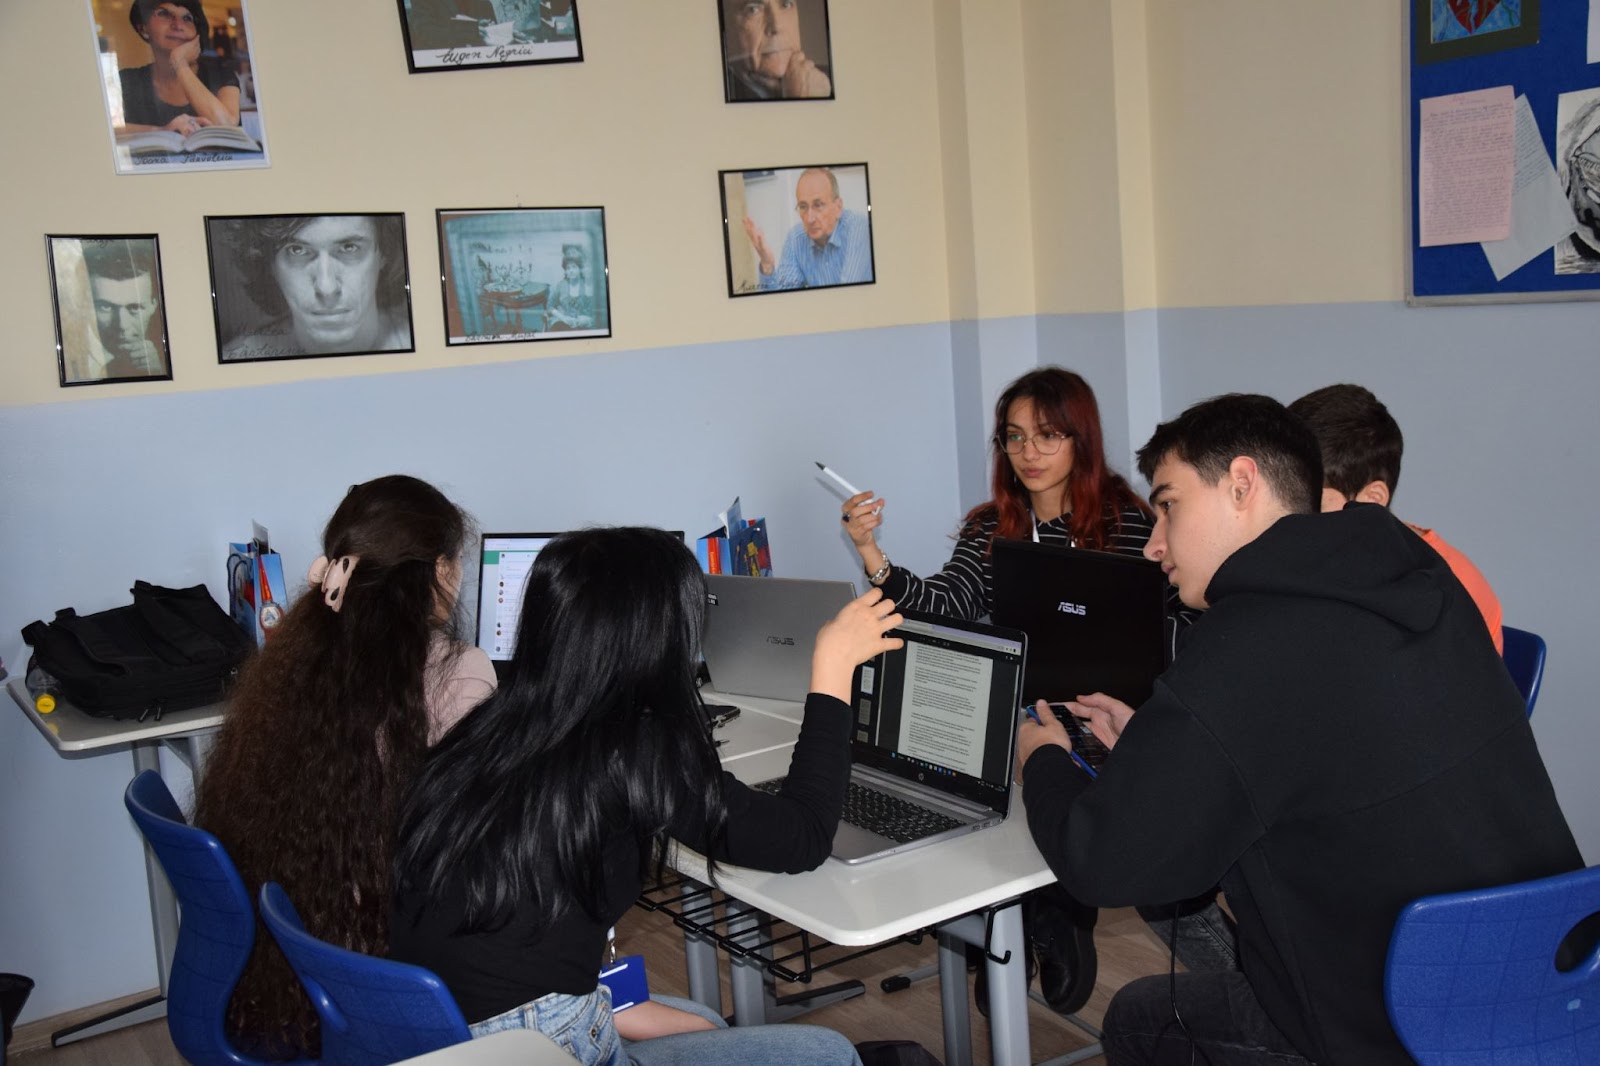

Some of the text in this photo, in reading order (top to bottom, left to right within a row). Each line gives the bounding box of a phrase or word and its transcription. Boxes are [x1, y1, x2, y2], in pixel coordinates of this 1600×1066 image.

[436, 47, 482, 65] Eugen
[1057, 601, 1086, 616] ASUS
[766, 635, 795, 646] ASUS
